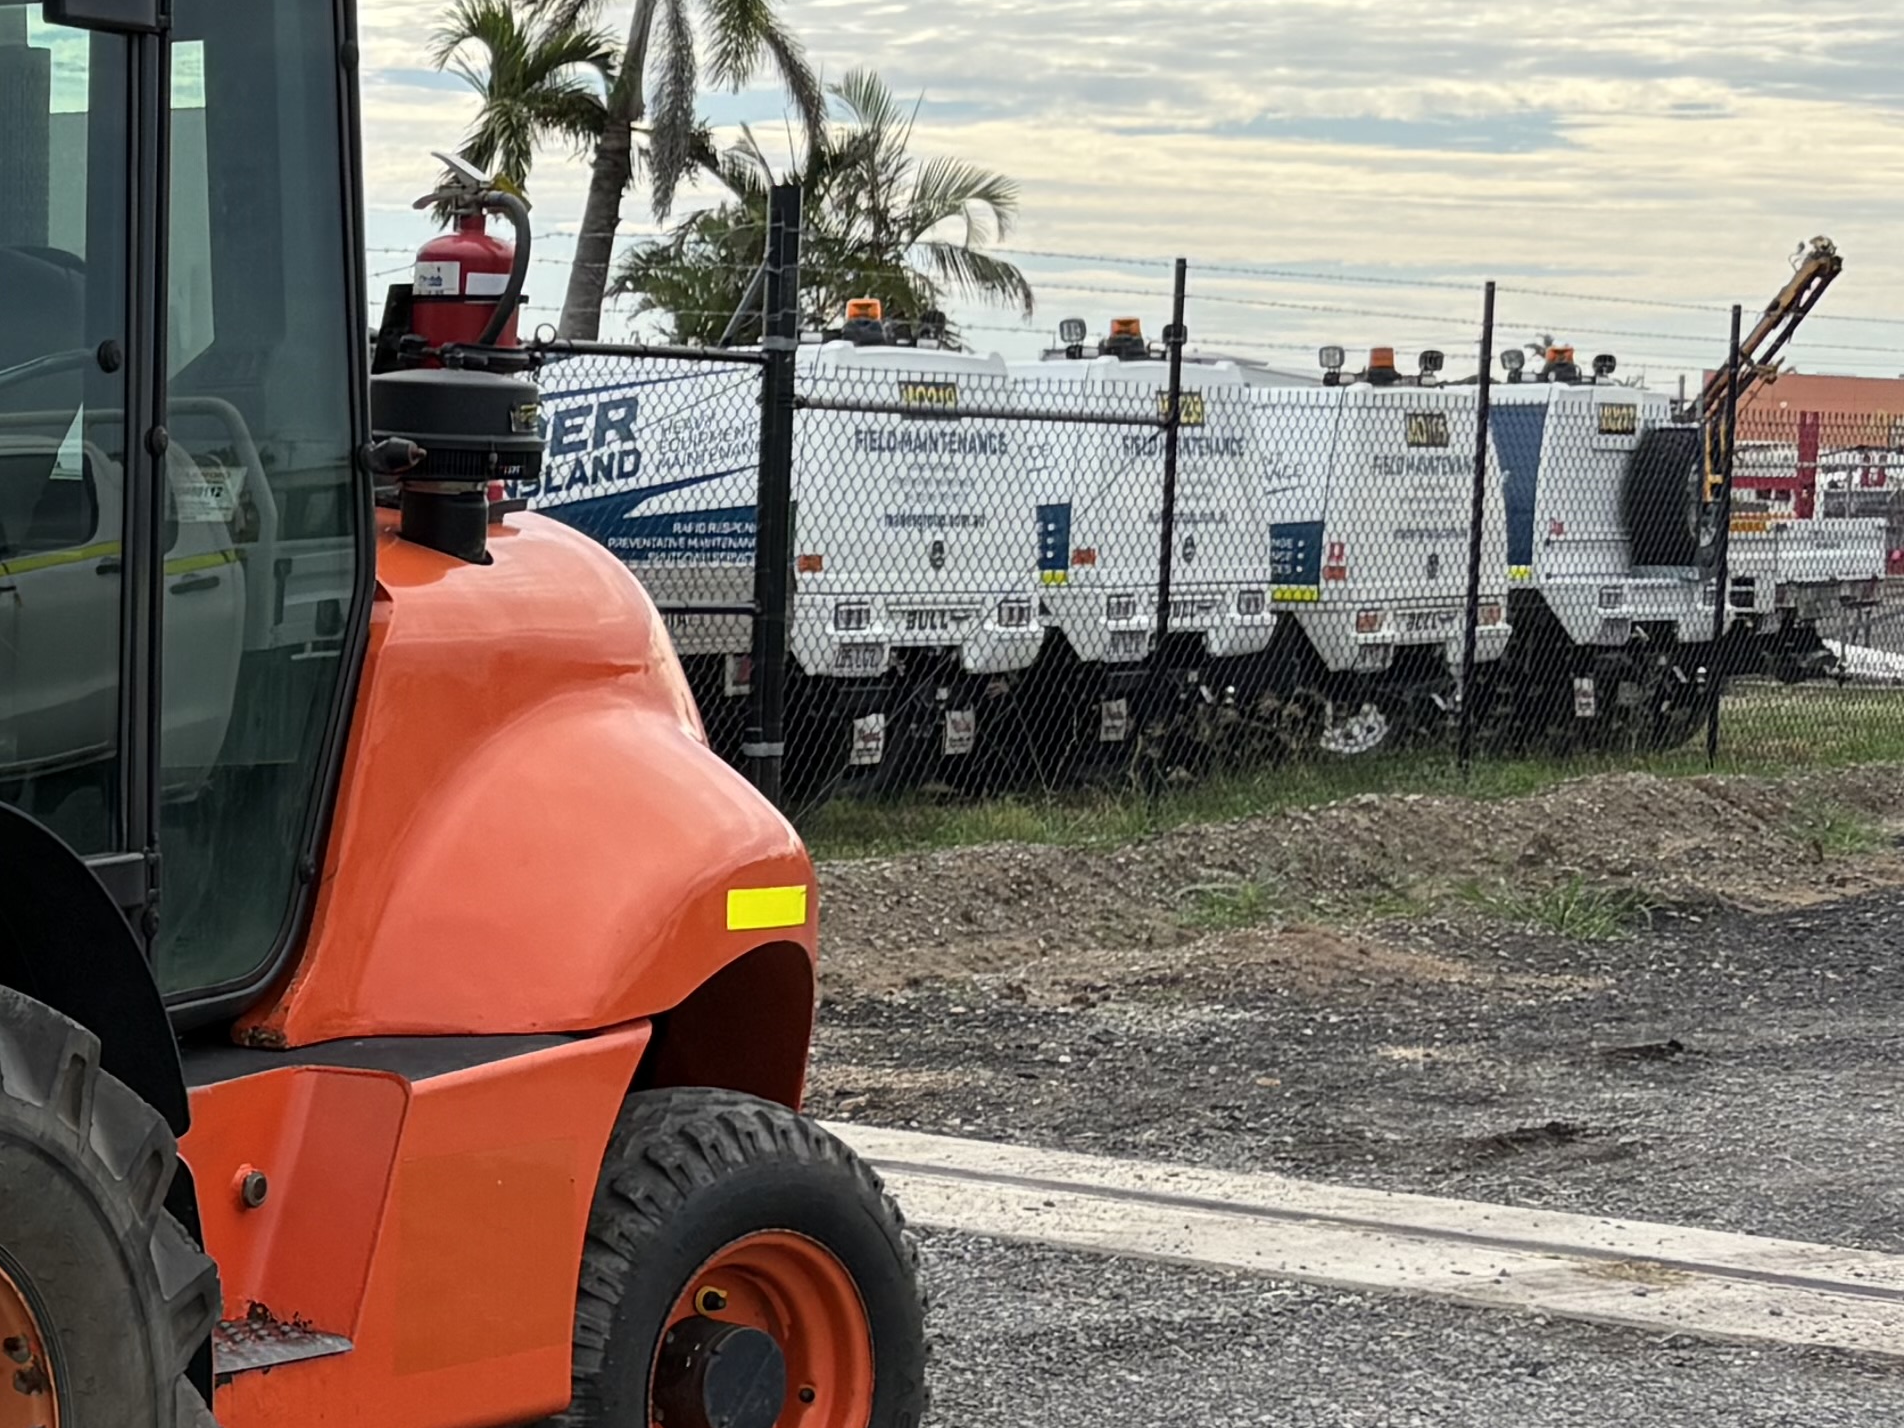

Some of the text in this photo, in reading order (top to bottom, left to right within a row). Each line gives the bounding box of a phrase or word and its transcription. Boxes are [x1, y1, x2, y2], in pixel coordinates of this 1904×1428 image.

[538, 398, 639, 457] ER
[853, 428, 895, 453] FIELD
[899, 429, 1008, 456] MAINTENANCE
[659, 439, 760, 468] MAINTENAN
